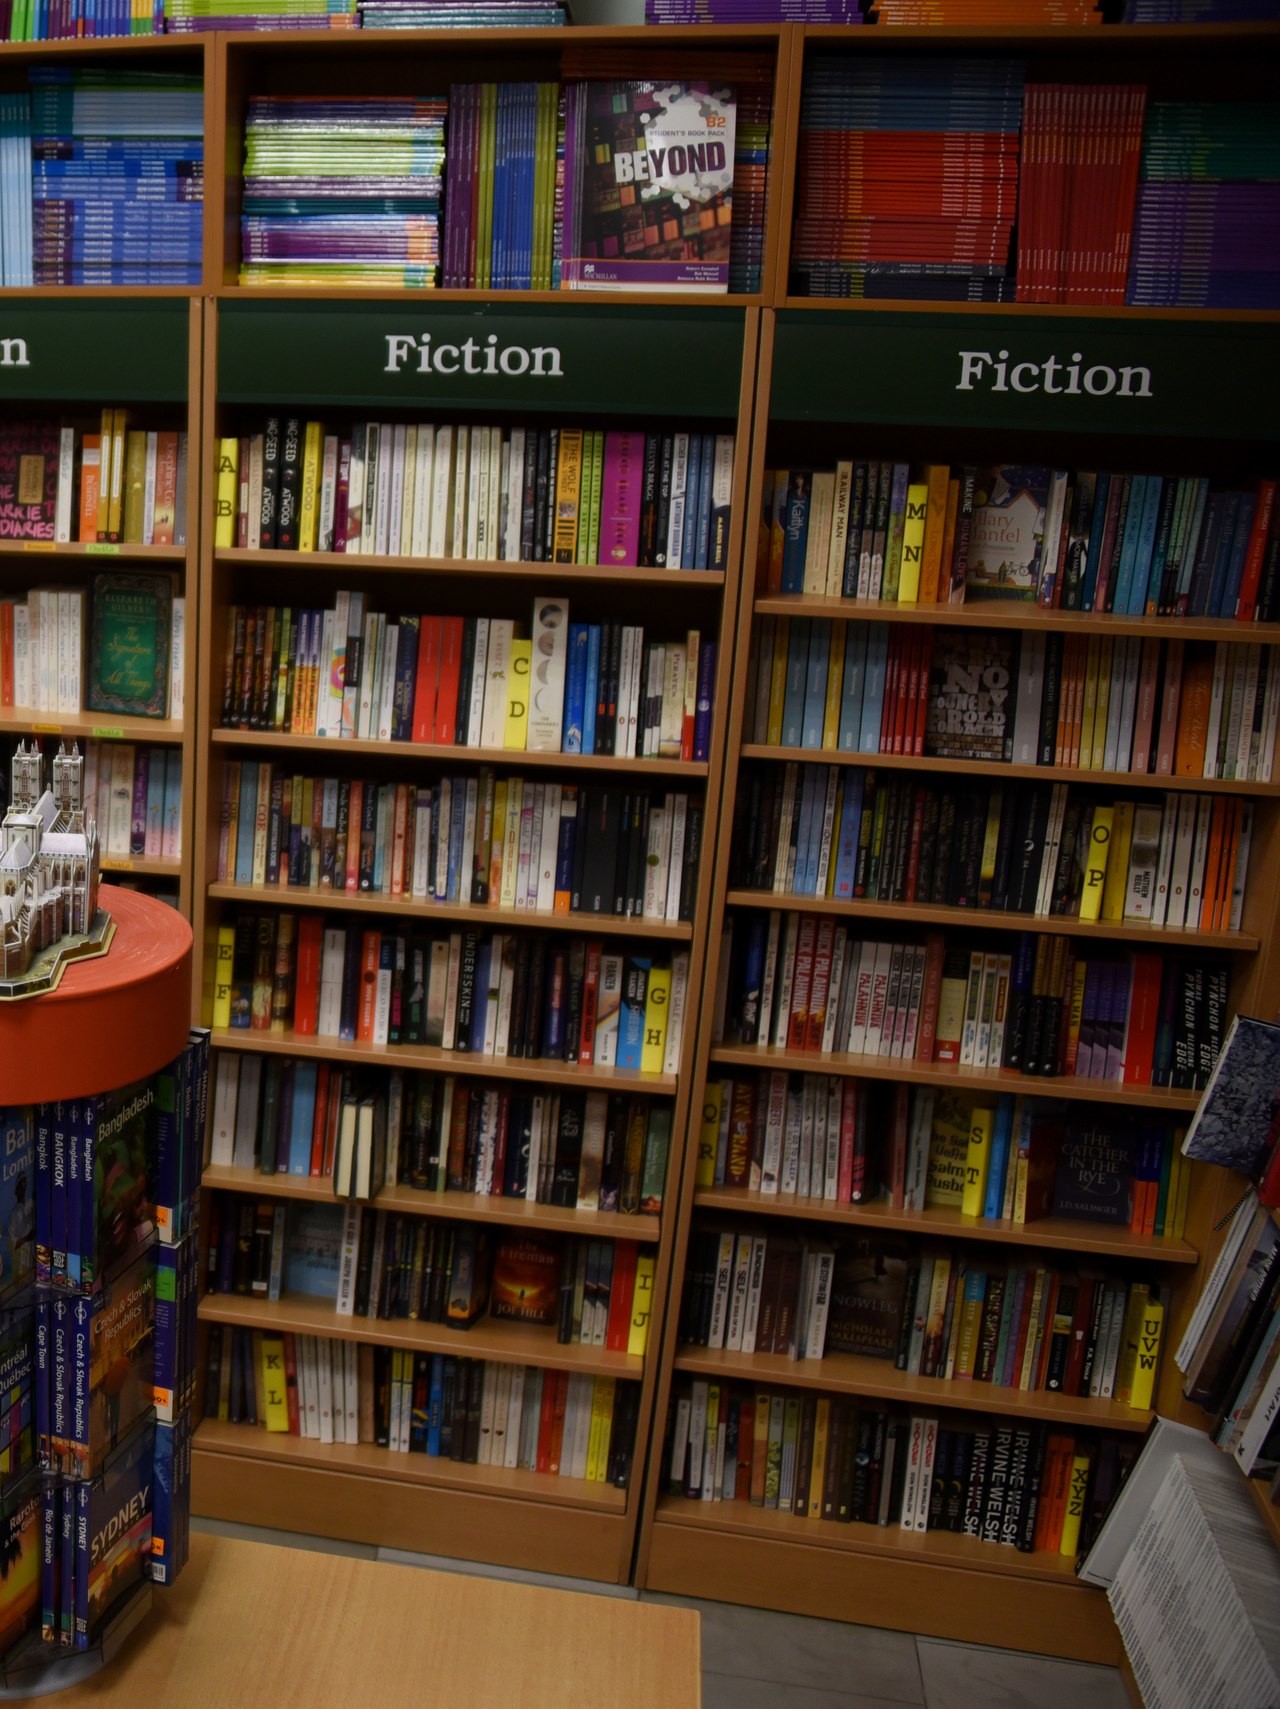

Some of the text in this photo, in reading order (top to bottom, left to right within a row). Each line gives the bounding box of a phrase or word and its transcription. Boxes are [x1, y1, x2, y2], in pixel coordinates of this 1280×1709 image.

[706, 115, 727, 129] B2
[613, 141, 727, 184] BEYOND
[383, 333, 565, 379] Fiction
[955, 350, 1156, 400] Fiction
[217, 455, 237, 473] A
[261, 417, 279, 526] HAG-SEED ATWOOD
[280, 418, 300, 527] HAG-SEED ATWOOD
[304, 459, 314, 512] ATWOOD
[567, 466, 578, 494] WOLF
[217, 499, 233, 517] B
[962, 477, 976, 513] MAKINE
[789, 499, 806, 541] Kaitlyn
[907, 502, 927, 520] M
[0, 519, 56, 539] DIARIES
[904, 546, 922, 562] N
[513, 657, 530, 676] C
[943, 663, 1011, 695] NO
[509, 700, 526, 718] D
[256, 802, 269, 832] COE
[1091, 824, 1110, 844] O
[1087, 867, 1105, 888] P
[1133, 870, 1151, 900] MATTHEW REILLY
[258, 916, 271, 946] ECO
[216, 944, 232, 961] E
[791, 919, 817, 1014] CHUCK PALAHNIUK
[809, 920, 835, 1015] CHUCK PALAHNIUK
[216, 983, 232, 1000] F
[650, 987, 667, 1005] G
[854, 972, 872, 1027] PALAHNIUK
[870, 974, 888, 1029] PALAHNIUK
[1070, 978, 1085, 1027] PULLMAN
[1184, 968, 1204, 1031] THOMAS PYNCHON
[1208, 970, 1228, 1031] THOMAS PYNCHON
[625, 1003, 642, 1046] FREEDOM
[645, 1028, 662, 1046] H
[1175, 1030, 1197, 1073] BLEEDING EDGE
[97, 1087, 154, 1144] Bangladesh
[703, 1103, 718, 1124] Q
[38, 1127, 49, 1171] Bangkok
[970, 1126, 984, 1145] S
[1083, 1130, 1112, 1148] THE
[54, 1131, 65, 1188] BANGKOK
[69, 1135, 79, 1180] Bangladesh
[83, 1137, 93, 1183] Bangladesh
[698, 1144, 715, 1160] R
[1061, 1142, 1129, 1163] CATCHER
[1069, 1155, 1120, 1174] IN THE
[966, 1167, 980, 1185] T
[1078, 1169, 1108, 1190] RYE
[1072, 1200, 1119, 1215] SALINGER
[751, 1243, 765, 1289] BLINDNESS
[638, 1273, 653, 1290] I
[718, 1267, 729, 1294] SELF
[736, 1270, 748, 1296] SELF
[633, 1312, 649, 1329] J
[1144, 1318, 1161, 1335] U
[37, 1324, 47, 1369] Cape Town
[55, 1327, 65, 1355] Czech
[75, 1333, 85, 1359] Czech
[1142, 1337, 1160, 1353] V
[265, 1352, 283, 1371] K
[1139, 1354, 1157, 1371] W
[55, 1366, 65, 1392] Slovak
[74, 1370, 85, 1396] Slovak
[268, 1389, 283, 1407] L
[55, 1392, 65, 1435] Republics
[74, 1396, 85, 1440] Republics
[962, 1432, 991, 1537] IRVINE WELSH
[982, 1427, 1014, 1545] IRVINE WELSH
[999, 1430, 1031, 1547] IRVINE WELSH
[1073, 1468, 1089, 1483] X
[1072, 1485, 1088, 1500] Y
[1069, 1501, 1082, 1516] Z
[44, 1508, 54, 1564] Rio de Janeiro
[62, 1513, 72, 1540] Sydney
[77, 1515, 87, 1551] SYDNEY
[91, 1484, 150, 1562] SYDNEY
